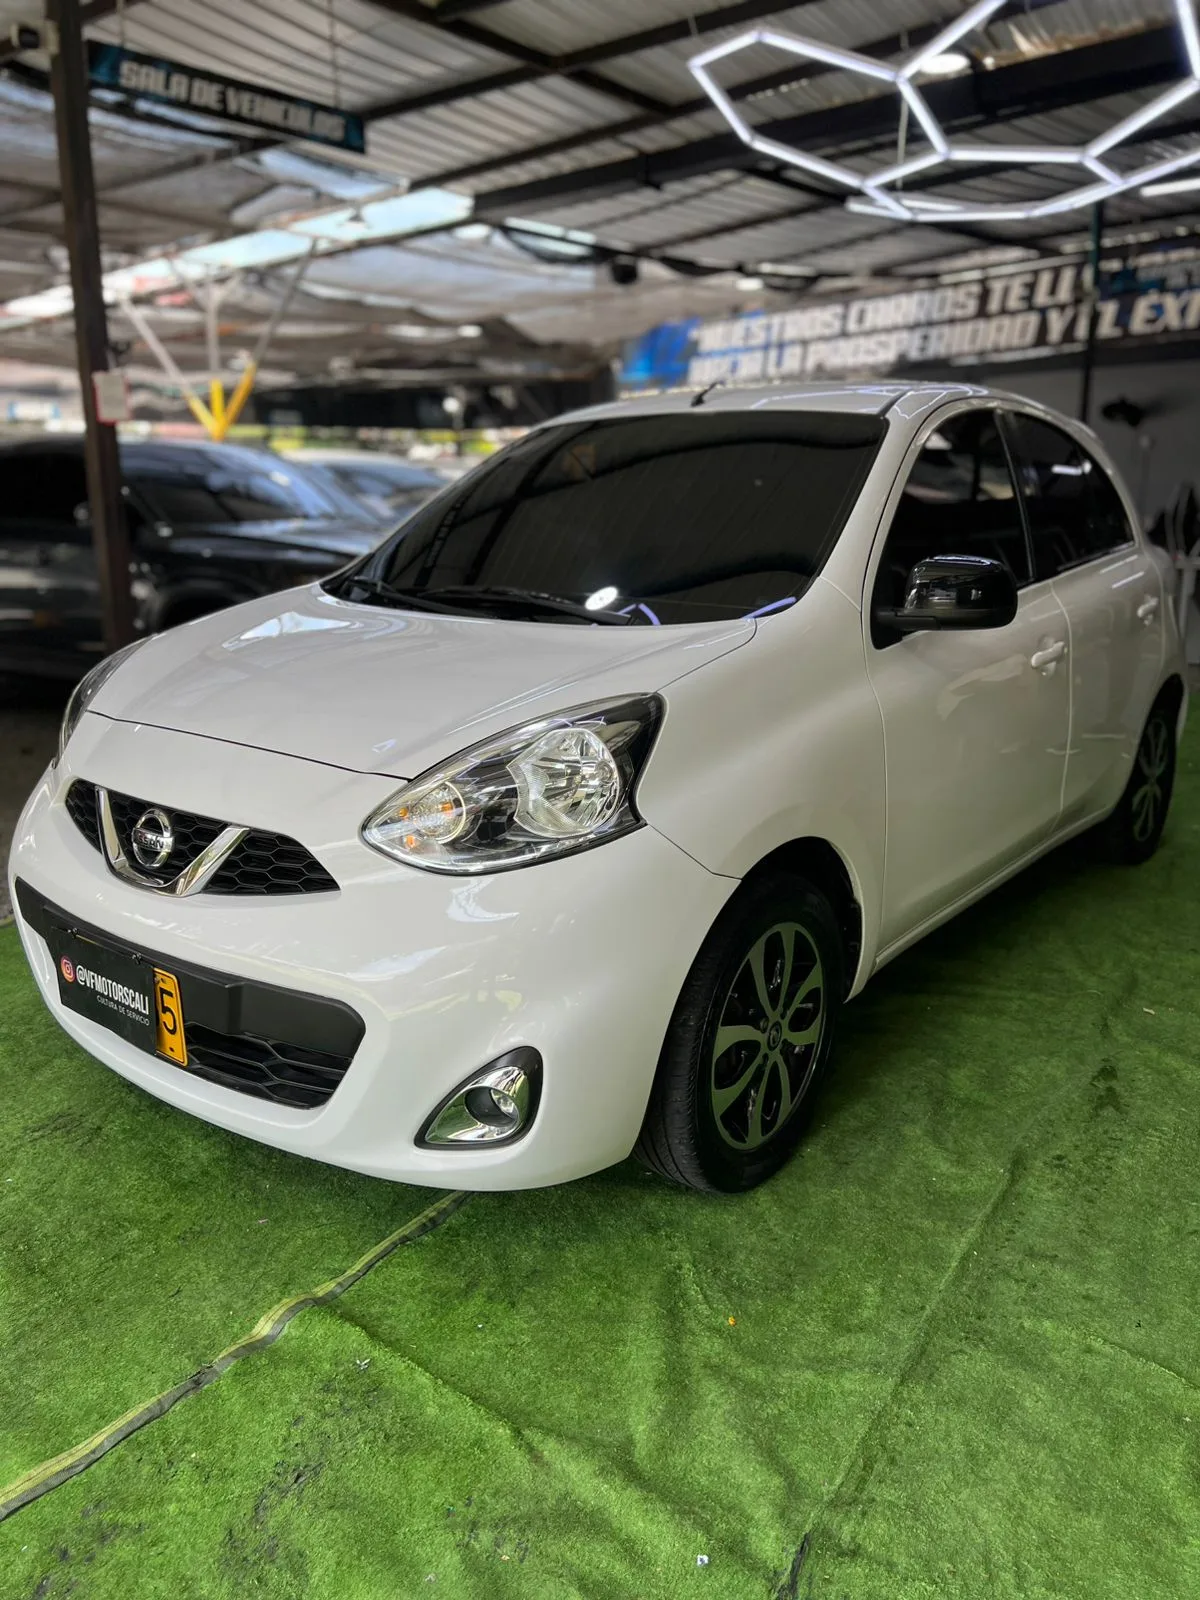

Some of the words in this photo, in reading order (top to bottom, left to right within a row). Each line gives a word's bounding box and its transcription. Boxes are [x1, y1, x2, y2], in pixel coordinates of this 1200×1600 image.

[190, 77, 226, 112] DE
[985, 271, 1036, 317] TE
[1045, 303, 1076, 345] Y
[76, 964, 150, 1015] @VFMOTORSCALI
[96, 995, 118, 1011] CULTURA
[118, 1005, 126, 1015] DE
[126, 1009, 150, 1026] SERVICIO
